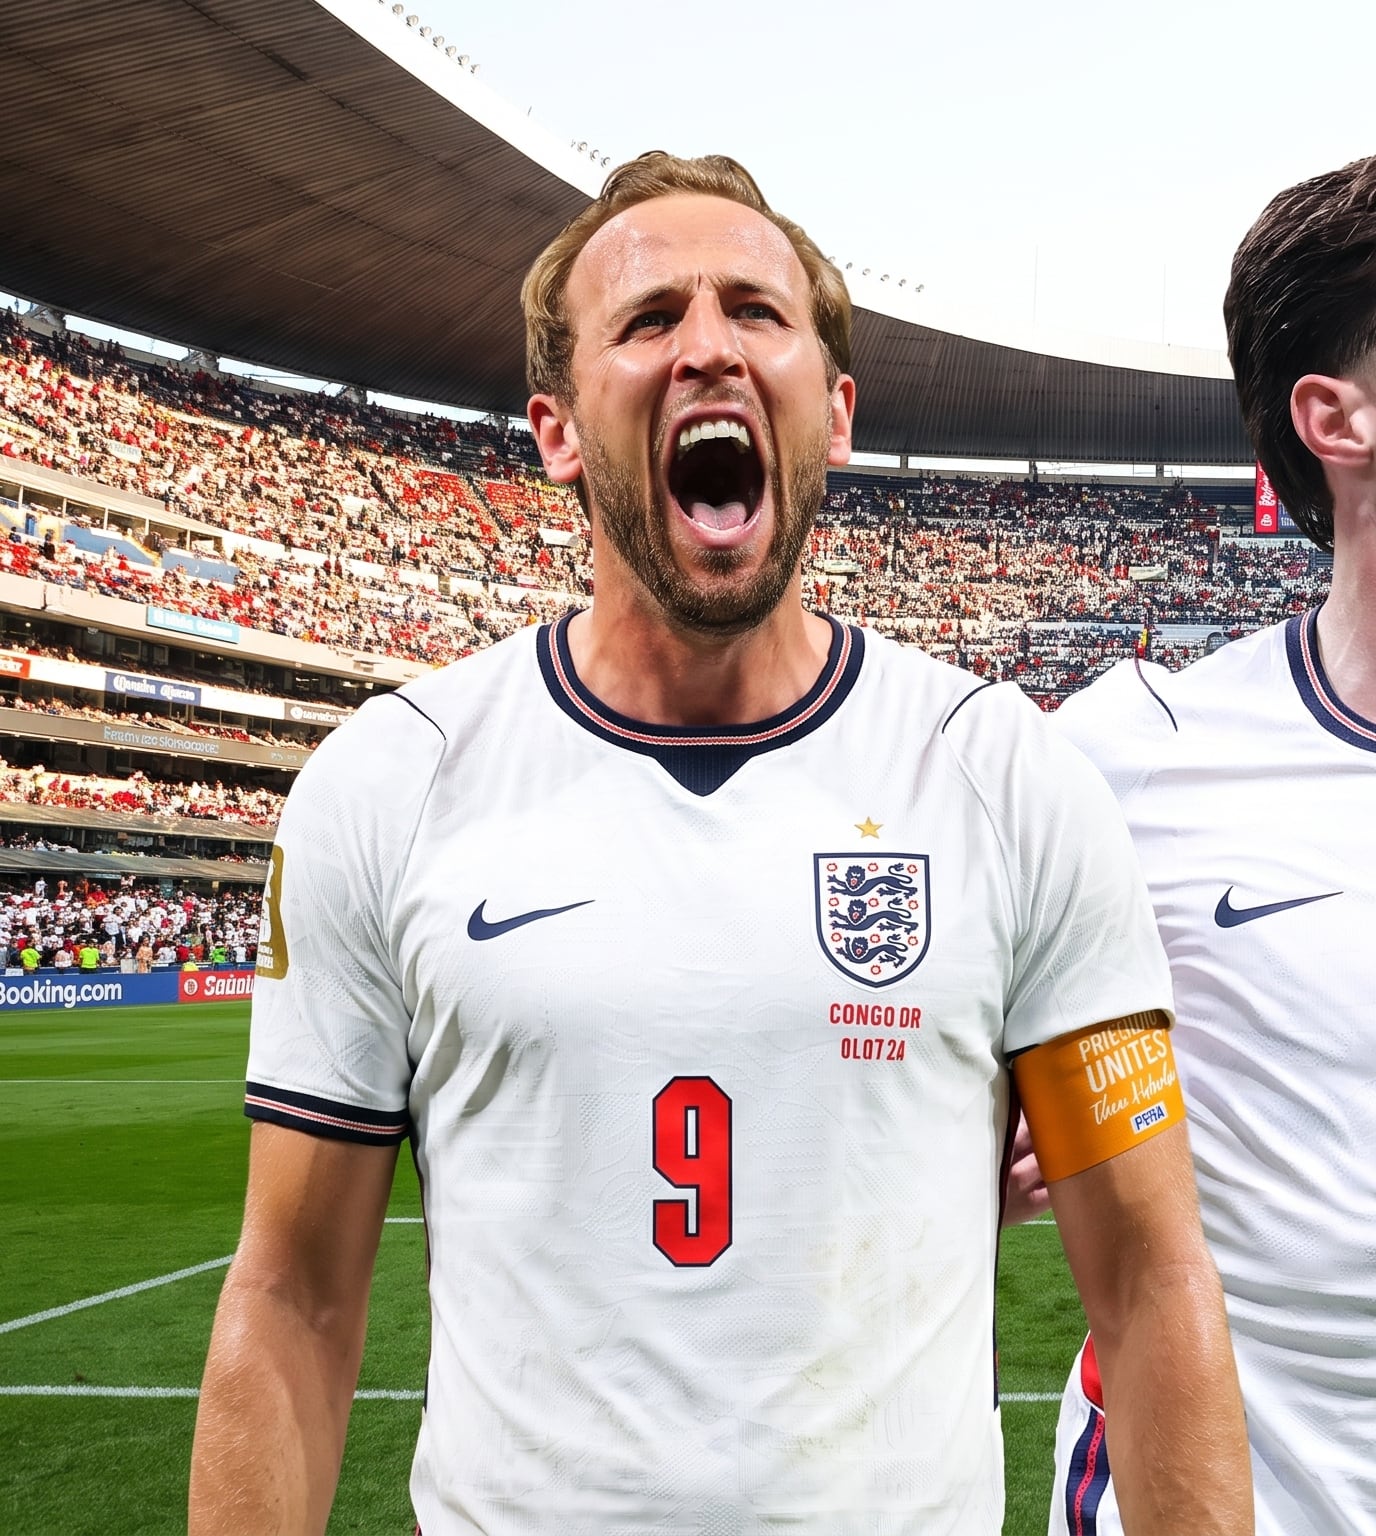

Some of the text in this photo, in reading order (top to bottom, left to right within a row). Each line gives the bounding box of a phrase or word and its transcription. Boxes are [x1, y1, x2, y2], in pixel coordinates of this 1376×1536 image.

[830, 1003, 922, 1029] CONGO DR
[1085, 1029, 1168, 1093] UNITES
[652, 1075, 733, 1268] 9
